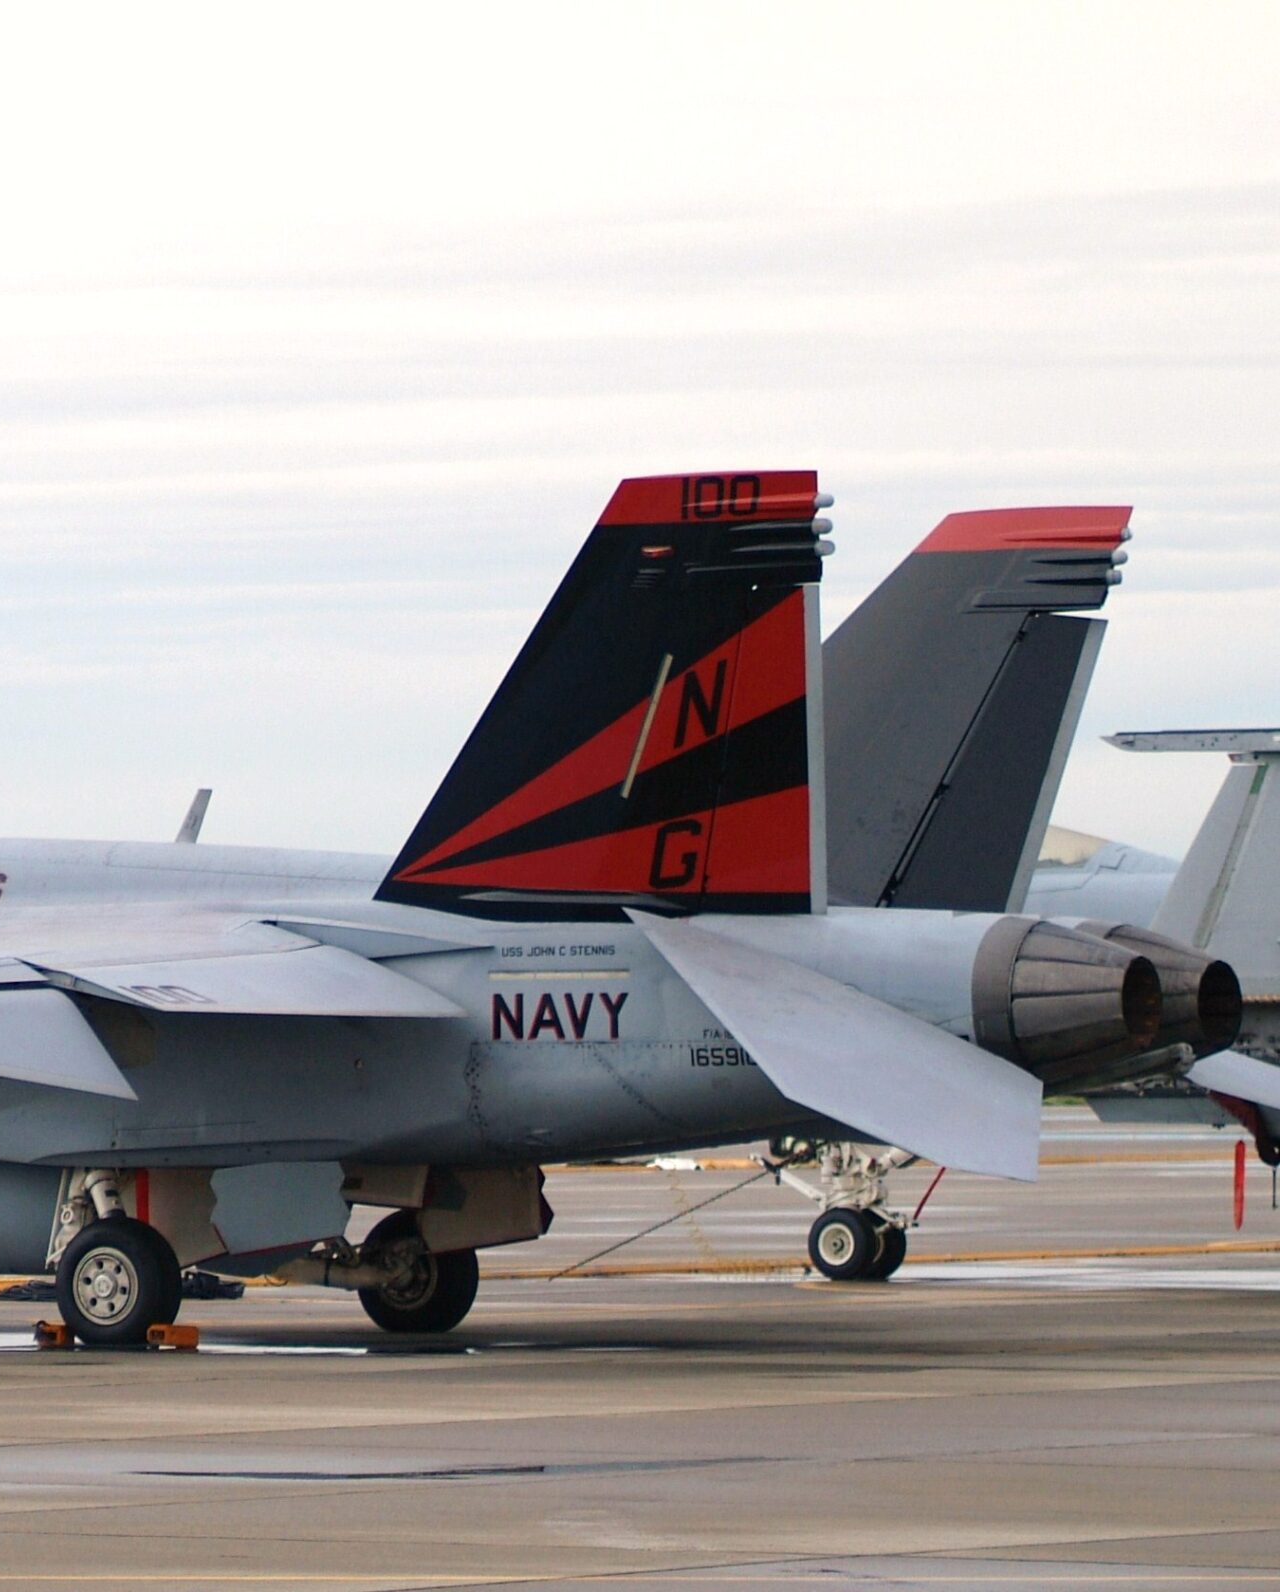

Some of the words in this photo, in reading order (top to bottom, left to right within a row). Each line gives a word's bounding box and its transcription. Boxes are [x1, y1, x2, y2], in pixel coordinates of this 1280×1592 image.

[681, 475, 760, 519] 100
[674, 659, 727, 749] N
[649, 818, 702, 889] G
[501, 947, 523, 957] USS
[526, 946, 555, 957] JOHN
[559, 946, 566, 956] C
[570, 945, 615, 956] STENNIS
[492, 992, 629, 1041] NAVY
